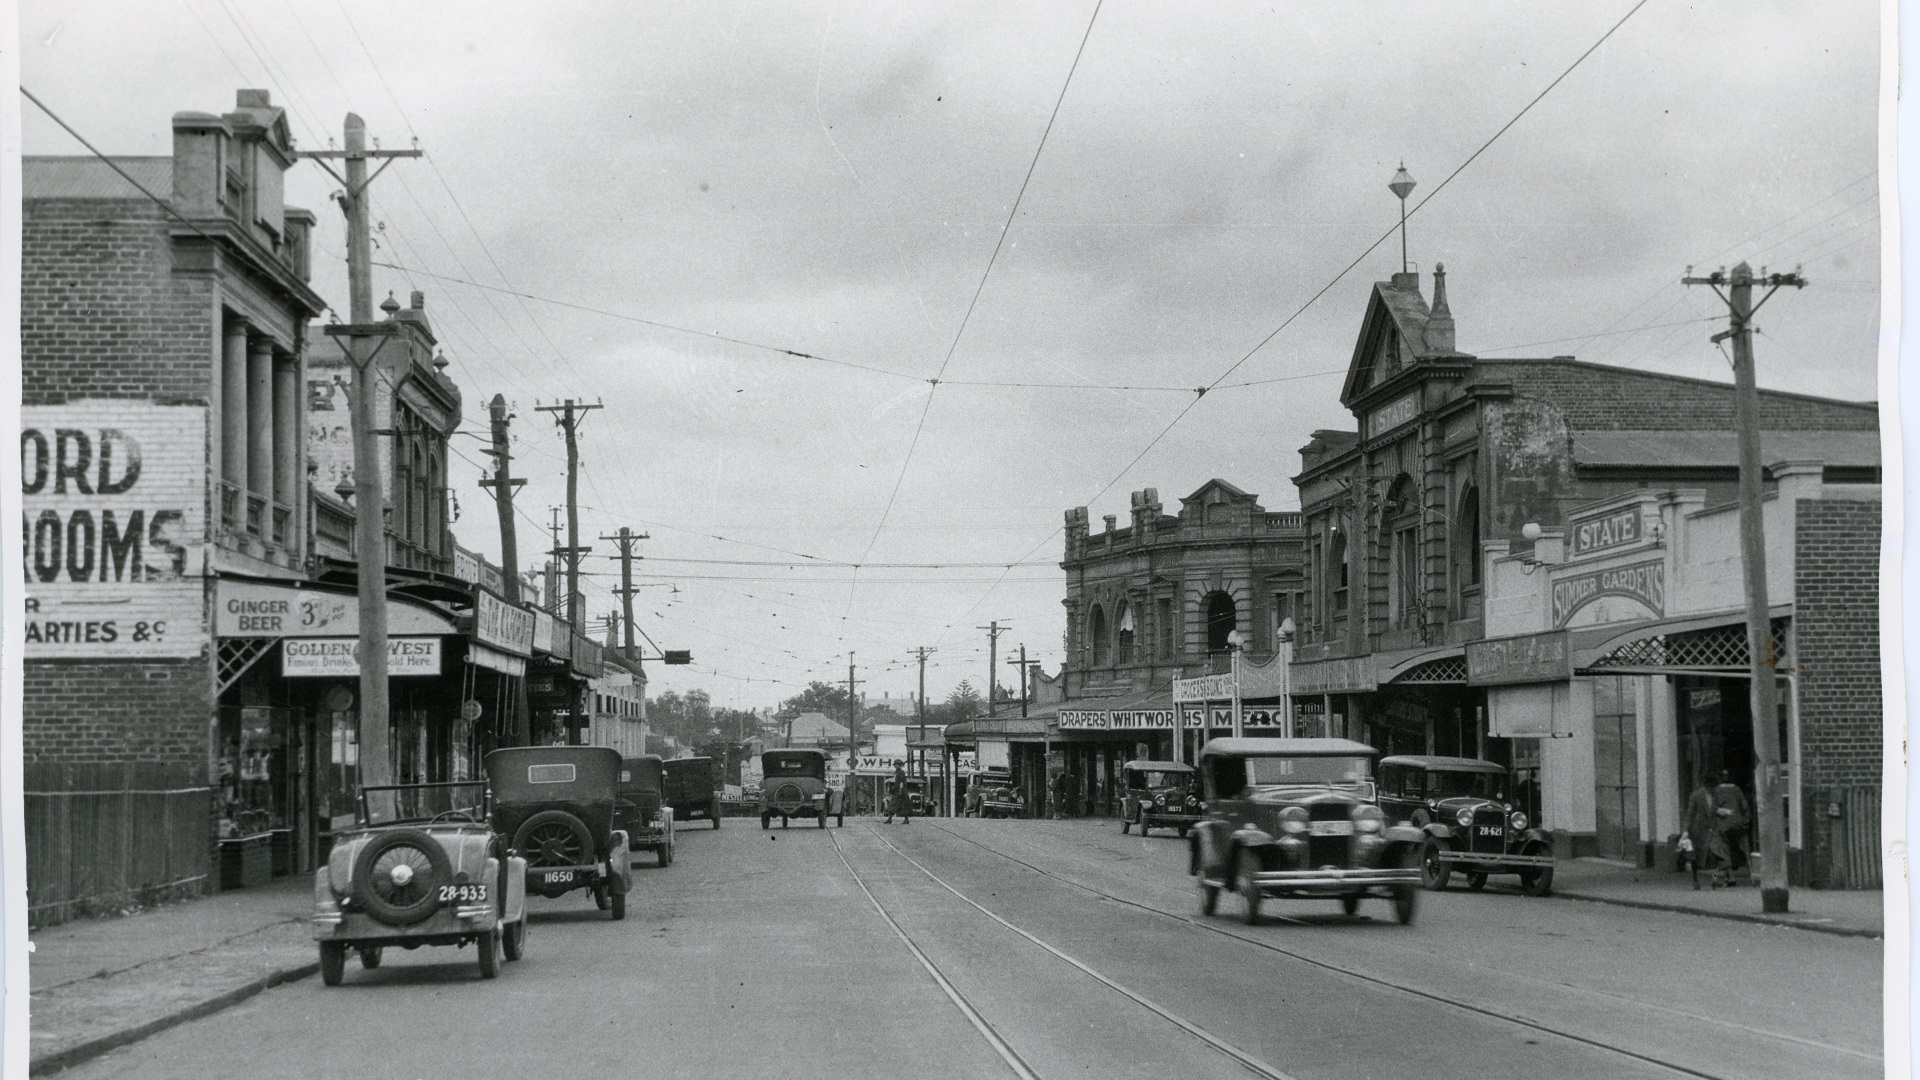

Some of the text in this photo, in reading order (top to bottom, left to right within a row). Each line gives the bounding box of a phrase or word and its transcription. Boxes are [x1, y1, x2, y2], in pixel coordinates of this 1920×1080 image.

[1379, 397, 1412, 430] STATE
[1580, 513, 1634, 550] STATE
[1553, 562, 1663, 625] SUMMER GARDENS
[227, 599, 289, 614] GINGER
[239, 616, 281, 631] BEER
[286, 641, 352, 656] GOLDEN
[287, 656, 318, 667] Famous
[322, 656, 353, 667] Drinks
[388, 655, 403, 666] old
[1061, 712, 1106, 726] DRAPERS
[1112, 711, 1204, 727] WHITWORHS'
[1480, 826, 1502, 836] 28-621
[545, 872, 573, 883] 11650
[438, 885, 487, 901] 28-933
